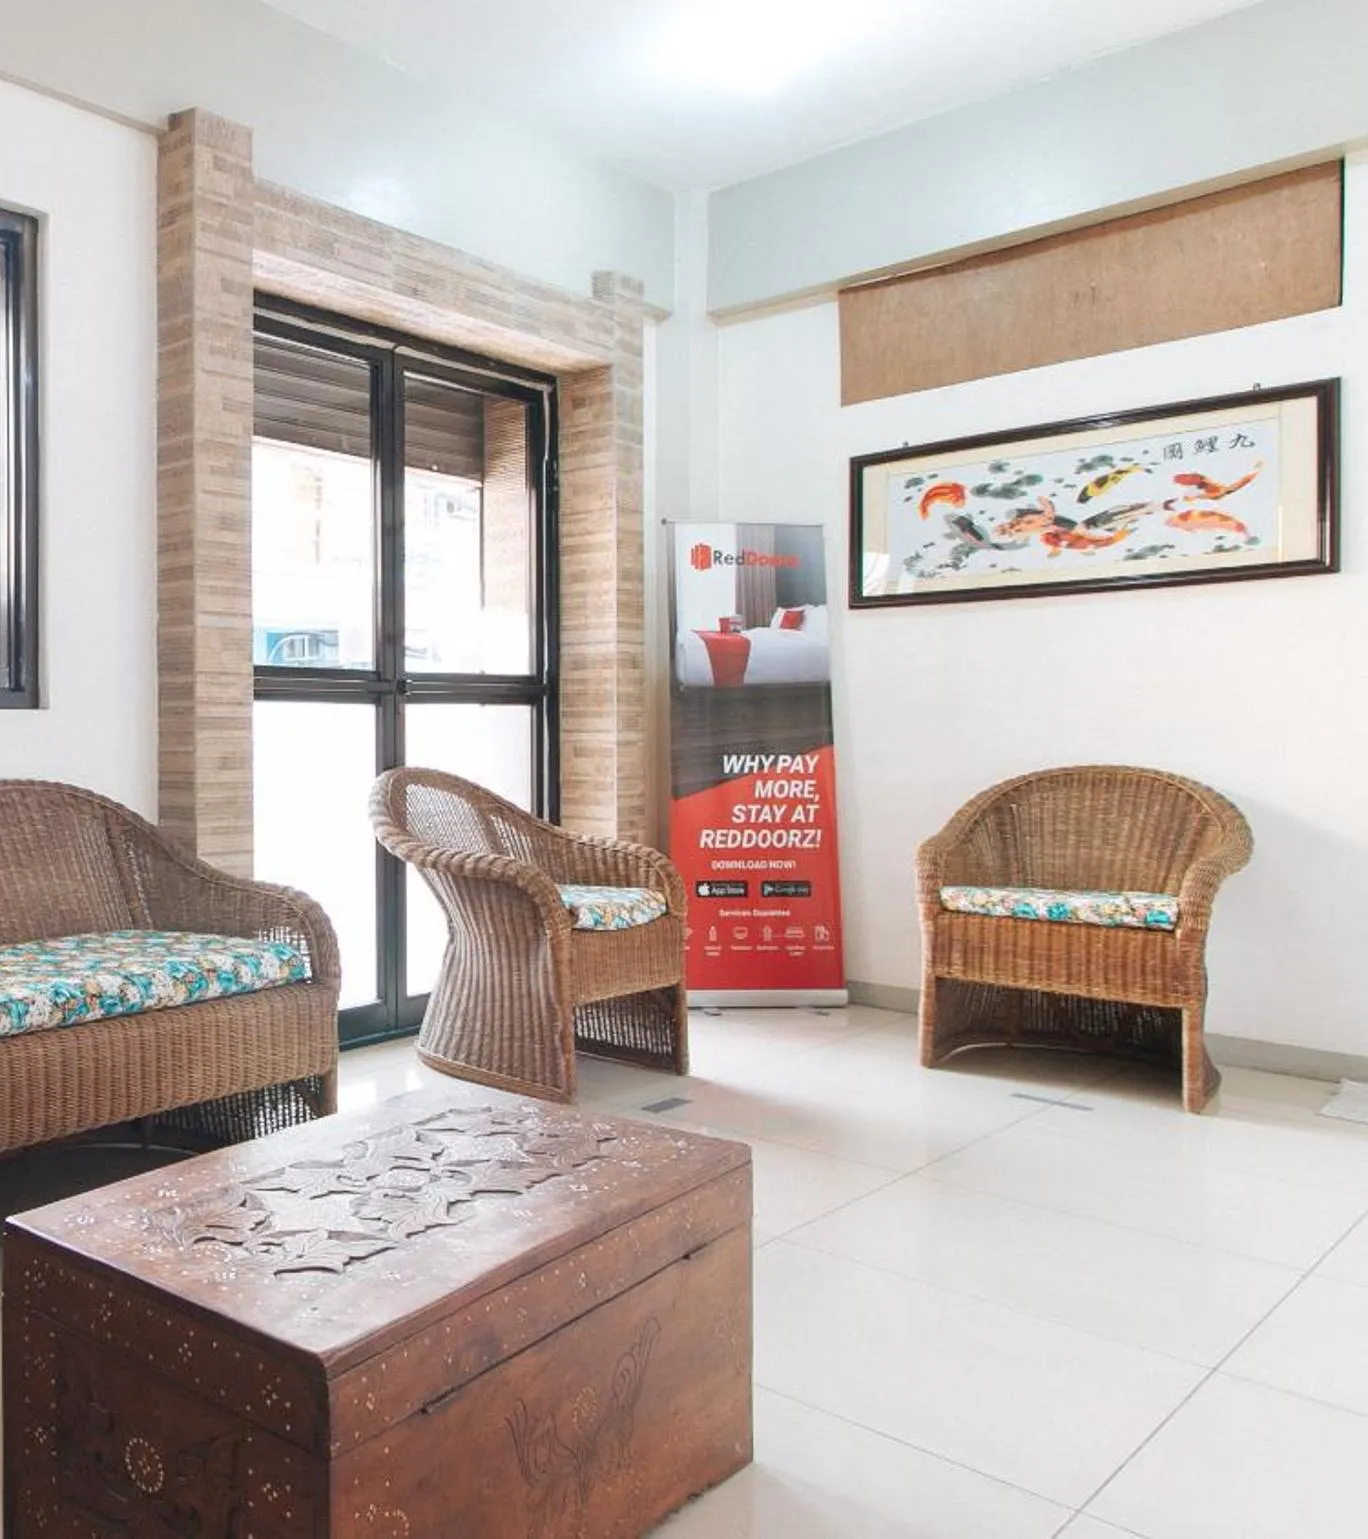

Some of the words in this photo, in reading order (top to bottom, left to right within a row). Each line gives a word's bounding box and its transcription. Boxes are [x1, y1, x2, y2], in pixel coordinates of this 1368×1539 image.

[723, 754, 774, 774] WHY
[776, 754, 819, 774] PAY
[754, 780, 820, 802] MORE,
[731, 804, 787, 823] STAY
[791, 804, 820, 823] AT
[699, 829, 822, 849] REDDOORZ!
[711, 860, 768, 869] DOWNLOAD
[769, 860, 796, 869] NOW!
